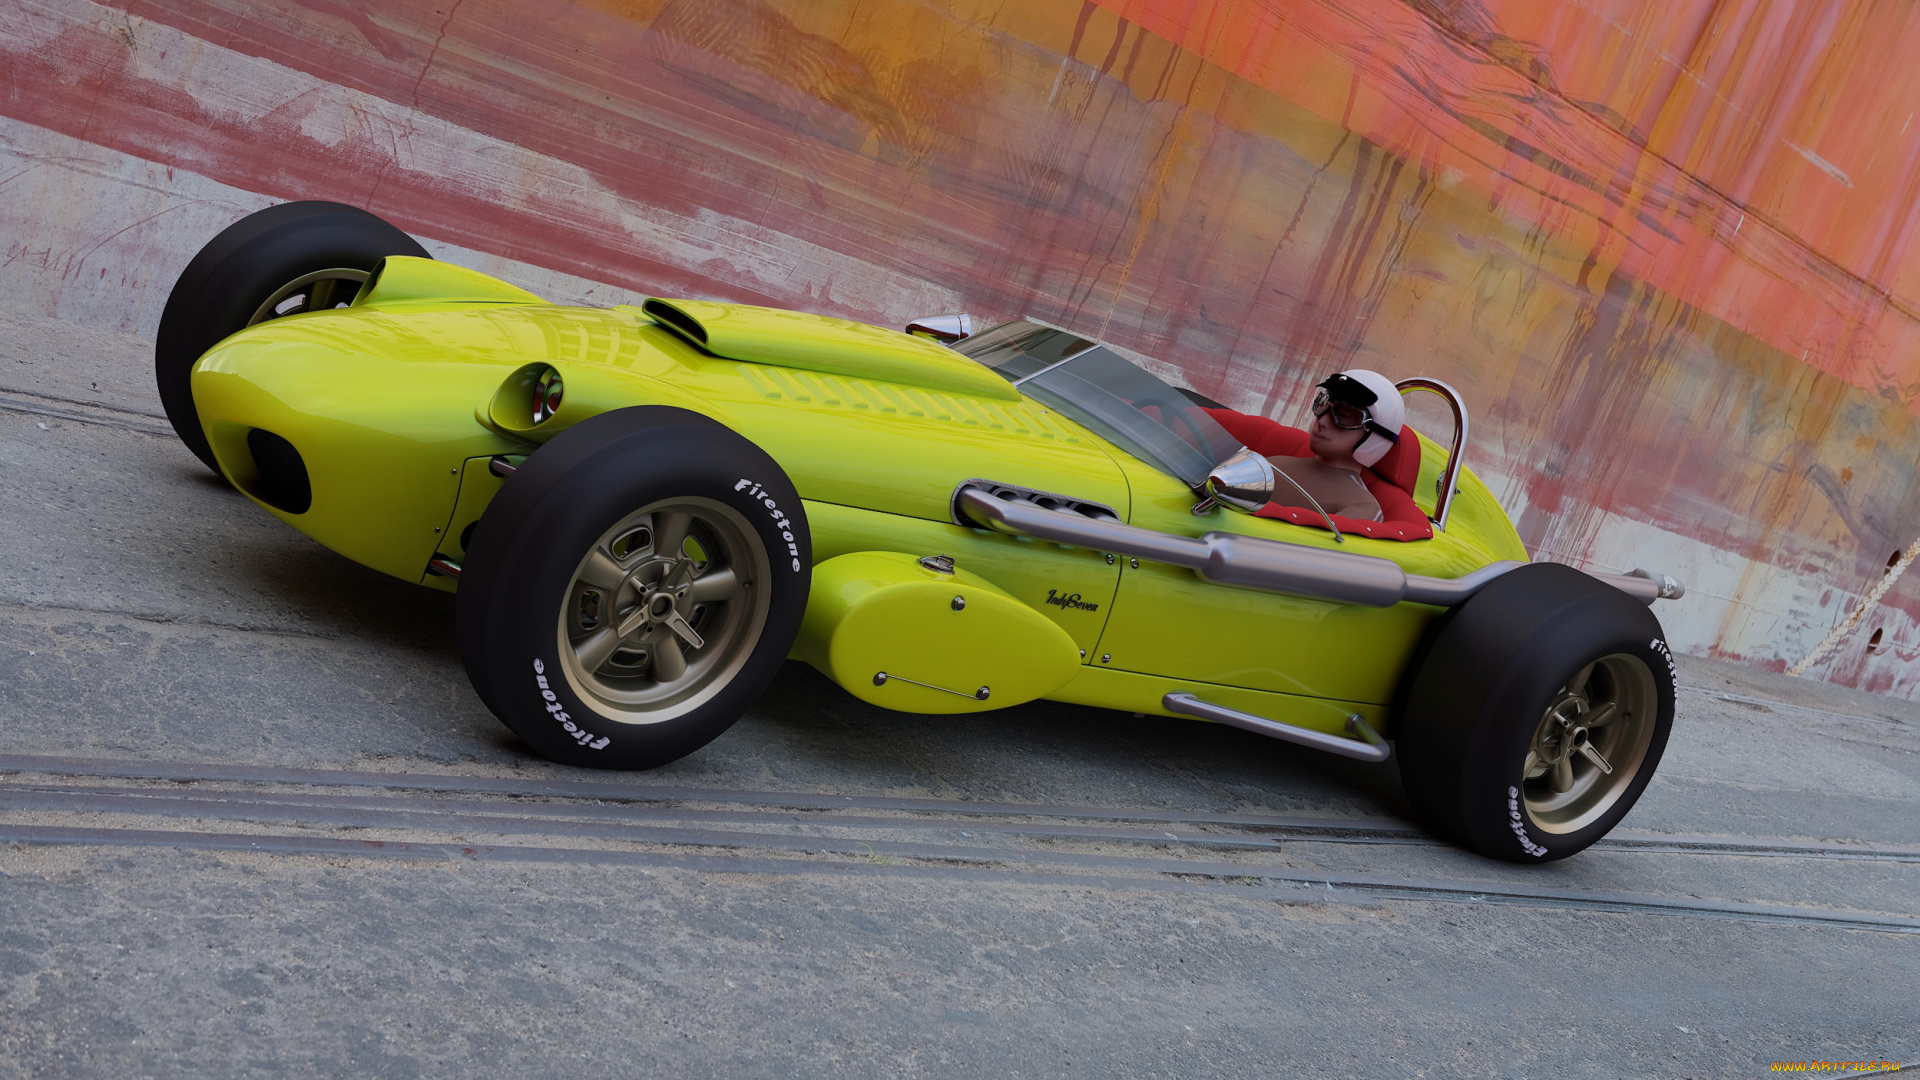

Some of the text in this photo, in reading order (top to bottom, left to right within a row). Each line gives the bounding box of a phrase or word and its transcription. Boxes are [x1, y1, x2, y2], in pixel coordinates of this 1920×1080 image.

[734, 478, 801, 573] Firestone
[533, 658, 611, 750] Firestone
[1507, 785, 1549, 857] Firestone
